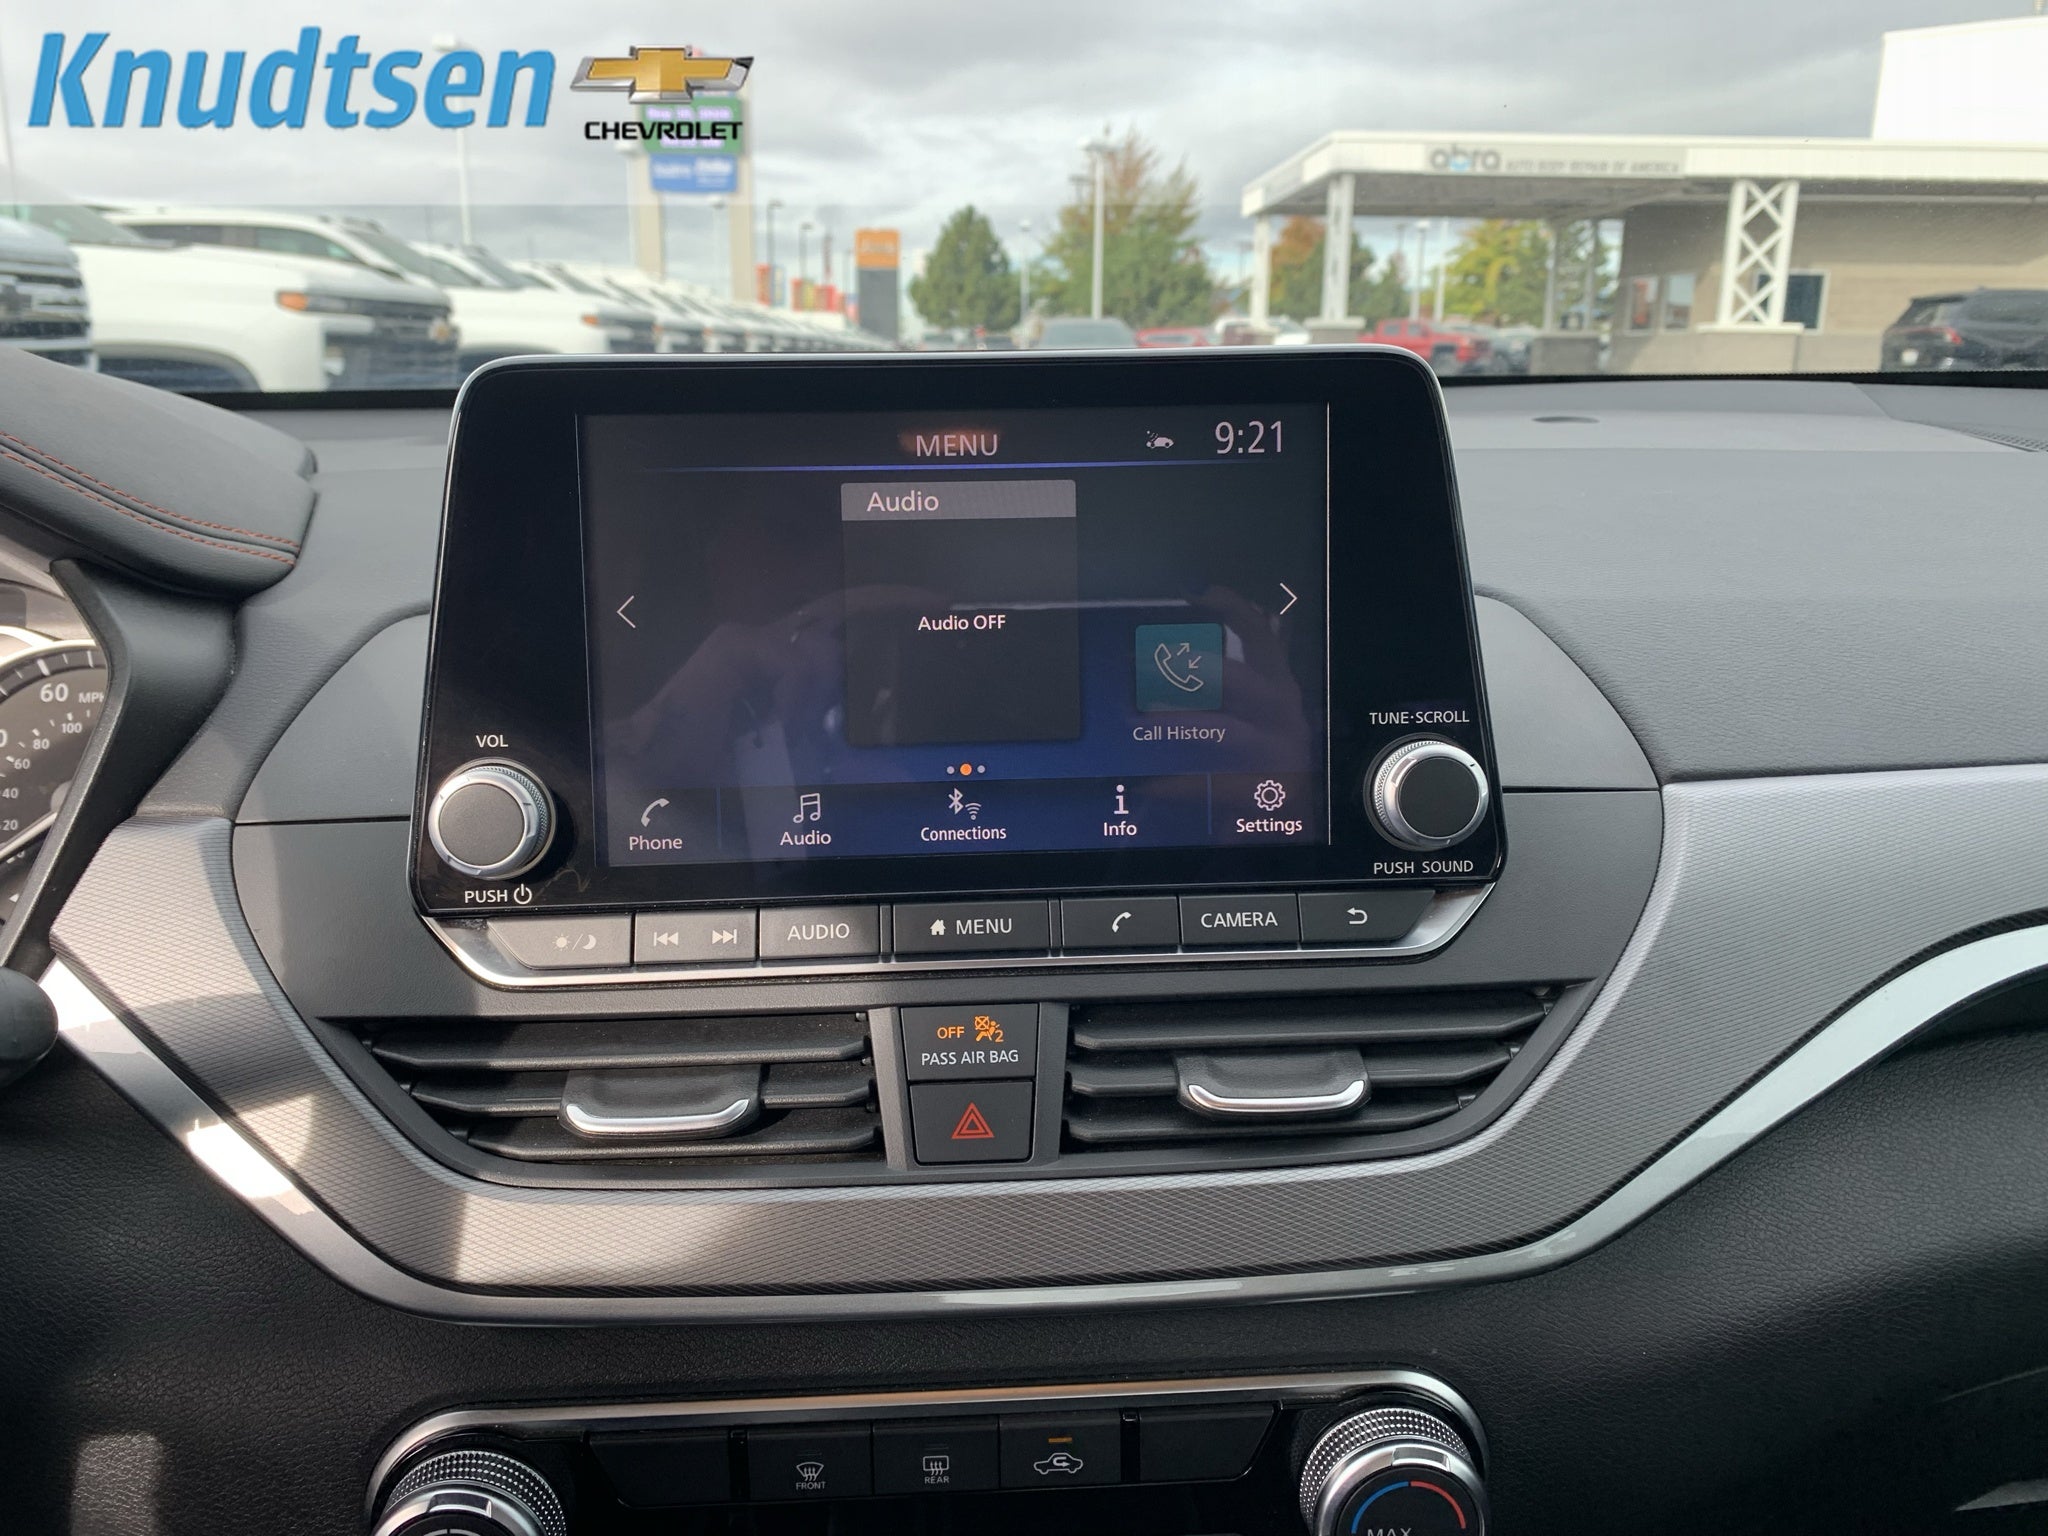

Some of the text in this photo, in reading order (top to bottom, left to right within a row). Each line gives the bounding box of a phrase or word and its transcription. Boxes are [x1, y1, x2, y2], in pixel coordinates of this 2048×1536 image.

[1429, 143, 1502, 172] abra
[1214, 420, 1285, 454] 9:21
[915, 434, 999, 457] MENU
[866, 490, 940, 512] Audio
[918, 614, 1007, 631] Audio OFF
[40, 683, 69, 702] 60
[61, 722, 83, 734] 100
[1132, 726, 1227, 744] Call History
[32, 738, 50, 750] 80
[475, 734, 509, 748] VOL
[14, 758, 31, 770] 60
[2, 787, 19, 799] 40
[3, 819, 19, 831] 20
[1103, 822, 1138, 837] Info
[1236, 817, 1303, 835] Settings
[780, 830, 833, 846] Audio
[920, 826, 1007, 843] Connections
[628, 835, 684, 851] Phone
[1373, 860, 1474, 875] PUSH SOUND
[464, 889, 508, 904] PUSH
[955, 918, 1013, 935] MENU
[1200, 911, 1279, 929] CAMERA
[787, 923, 850, 941] AUDIO
[936, 1026, 965, 1039] OFF
[921, 1049, 1019, 1066] PASS AIR BAG
[795, 1481, 827, 1491] FRONT
[924, 1475, 950, 1485] REAR
[1366, 1527, 1413, 1536] MAX
